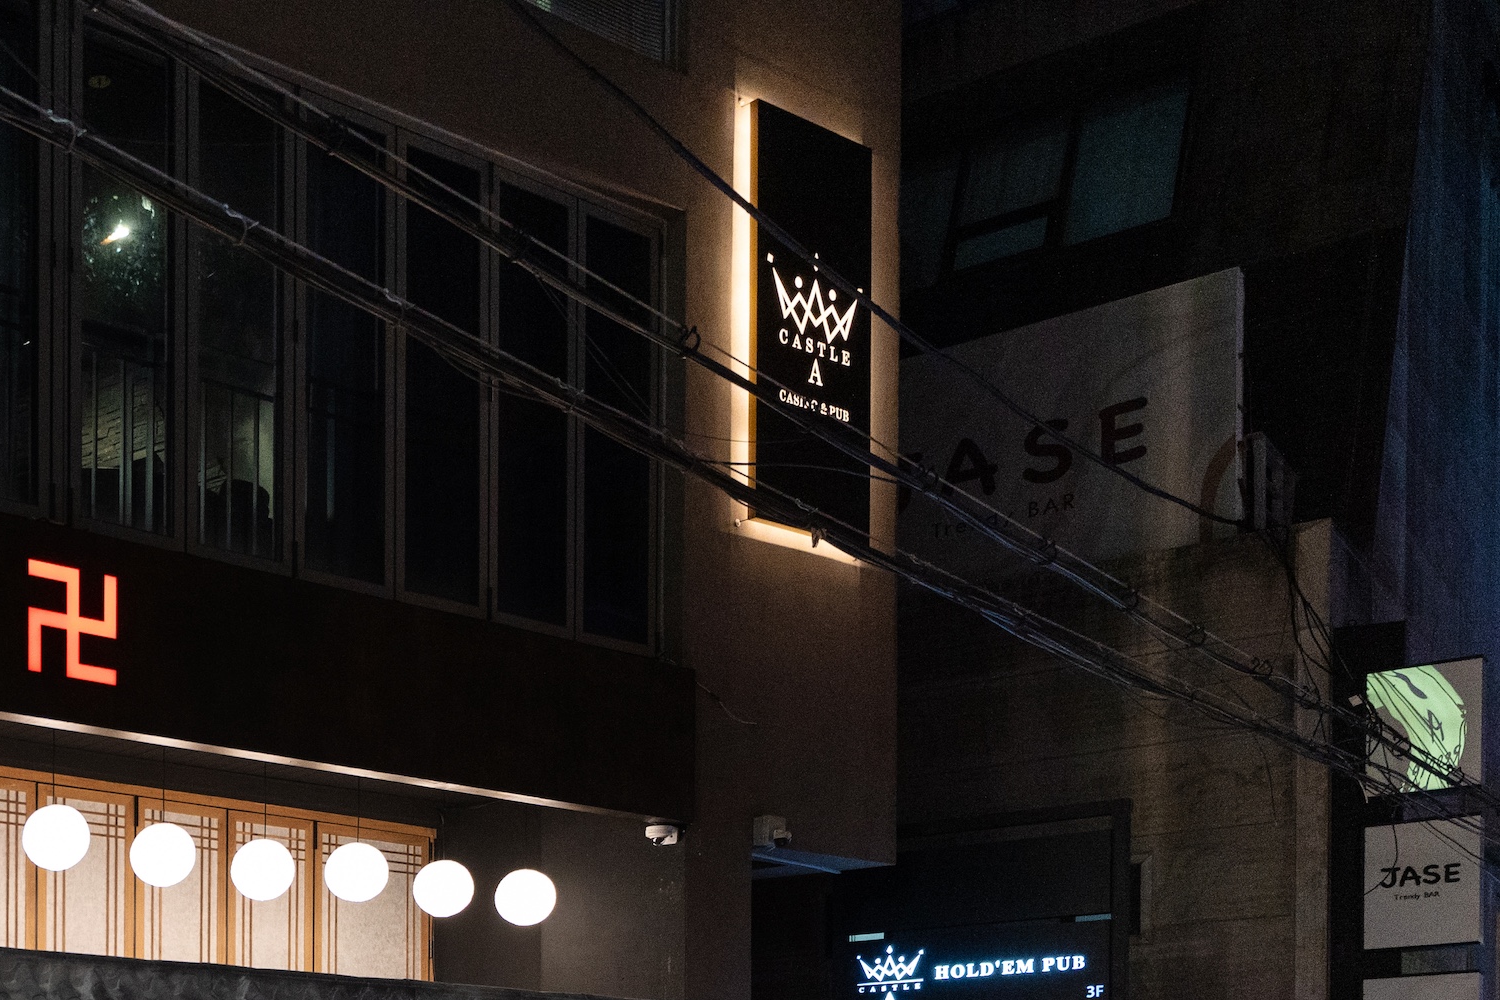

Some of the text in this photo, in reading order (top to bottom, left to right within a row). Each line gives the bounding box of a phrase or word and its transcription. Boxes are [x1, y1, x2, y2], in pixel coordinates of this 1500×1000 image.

[779, 328, 851, 367] CASTLE
[808, 358, 824, 387] A
[829, 405, 849, 422] PUB
[1028, 493, 1075, 518] BAR
[1380, 863, 1461, 888] JASE
[934, 955, 1086, 980] HOLD'EM PUB
[858, 982, 921, 993] CASTLE
[1086, 985, 1104, 998] 3F
